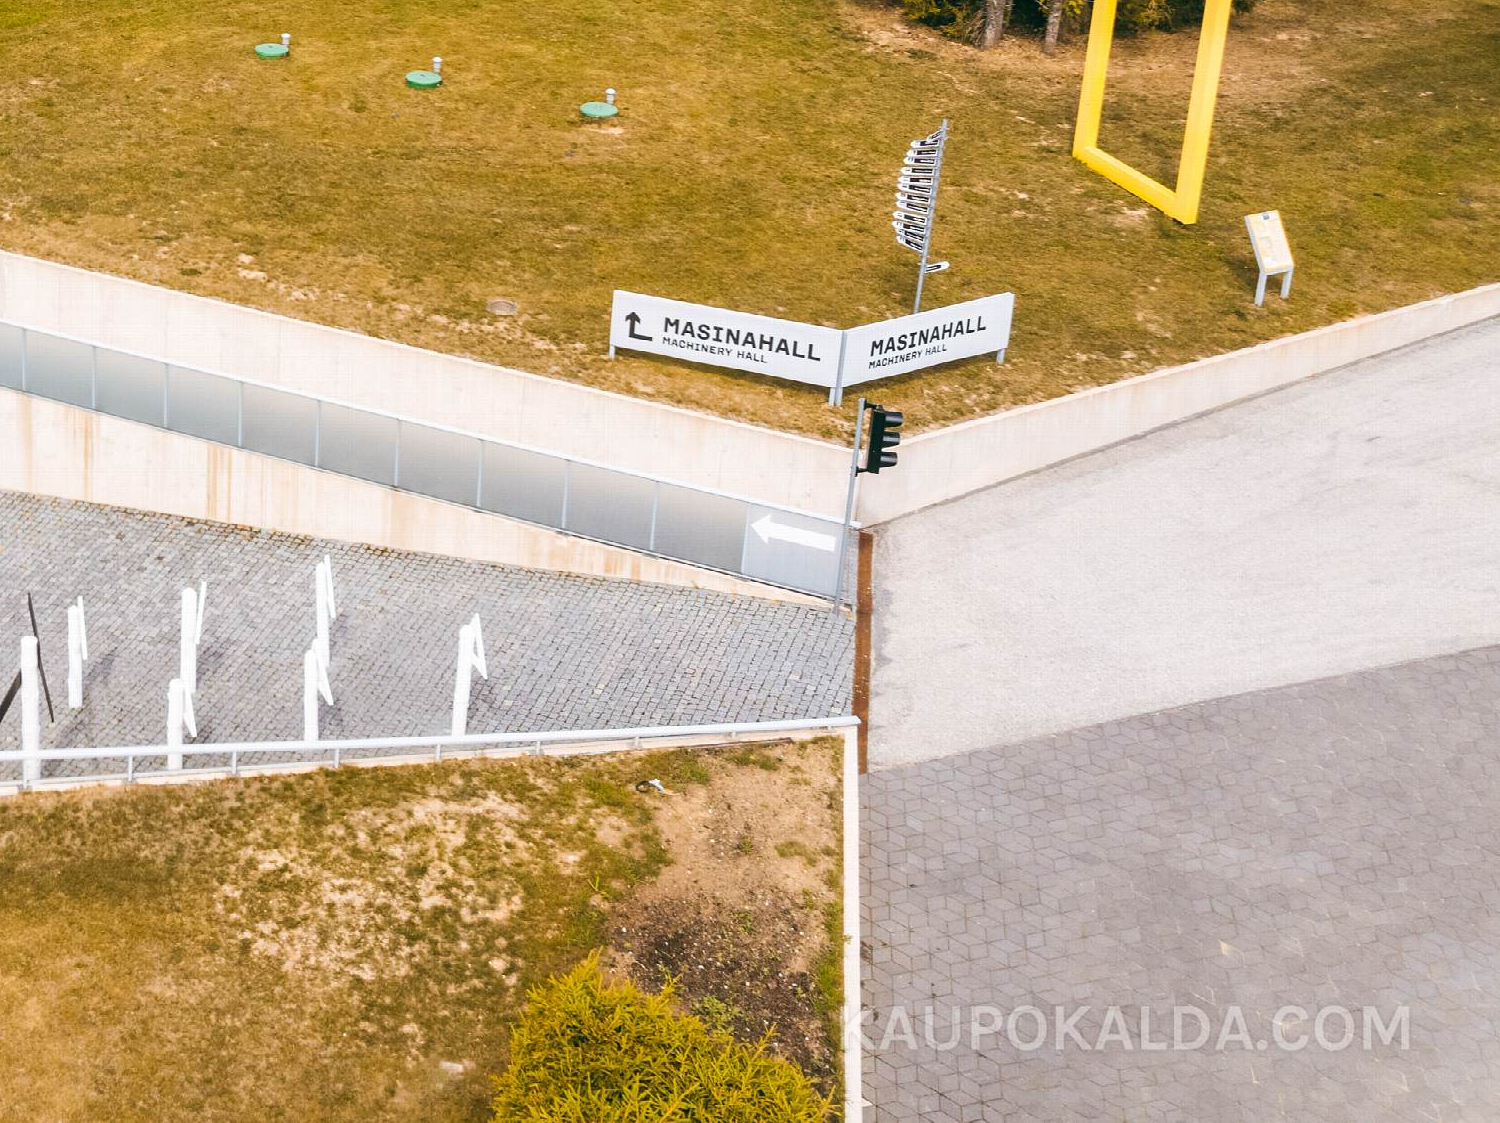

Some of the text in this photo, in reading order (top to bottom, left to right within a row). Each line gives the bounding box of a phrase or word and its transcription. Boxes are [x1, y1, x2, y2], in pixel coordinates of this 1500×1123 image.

[662, 336, 768, 364] MACHINERY HALL
[664, 317, 821, 362] MASINAHALL
[870, 316, 987, 357] MASINAHALL
[868, 343, 947, 369] MACHINERY HALL
